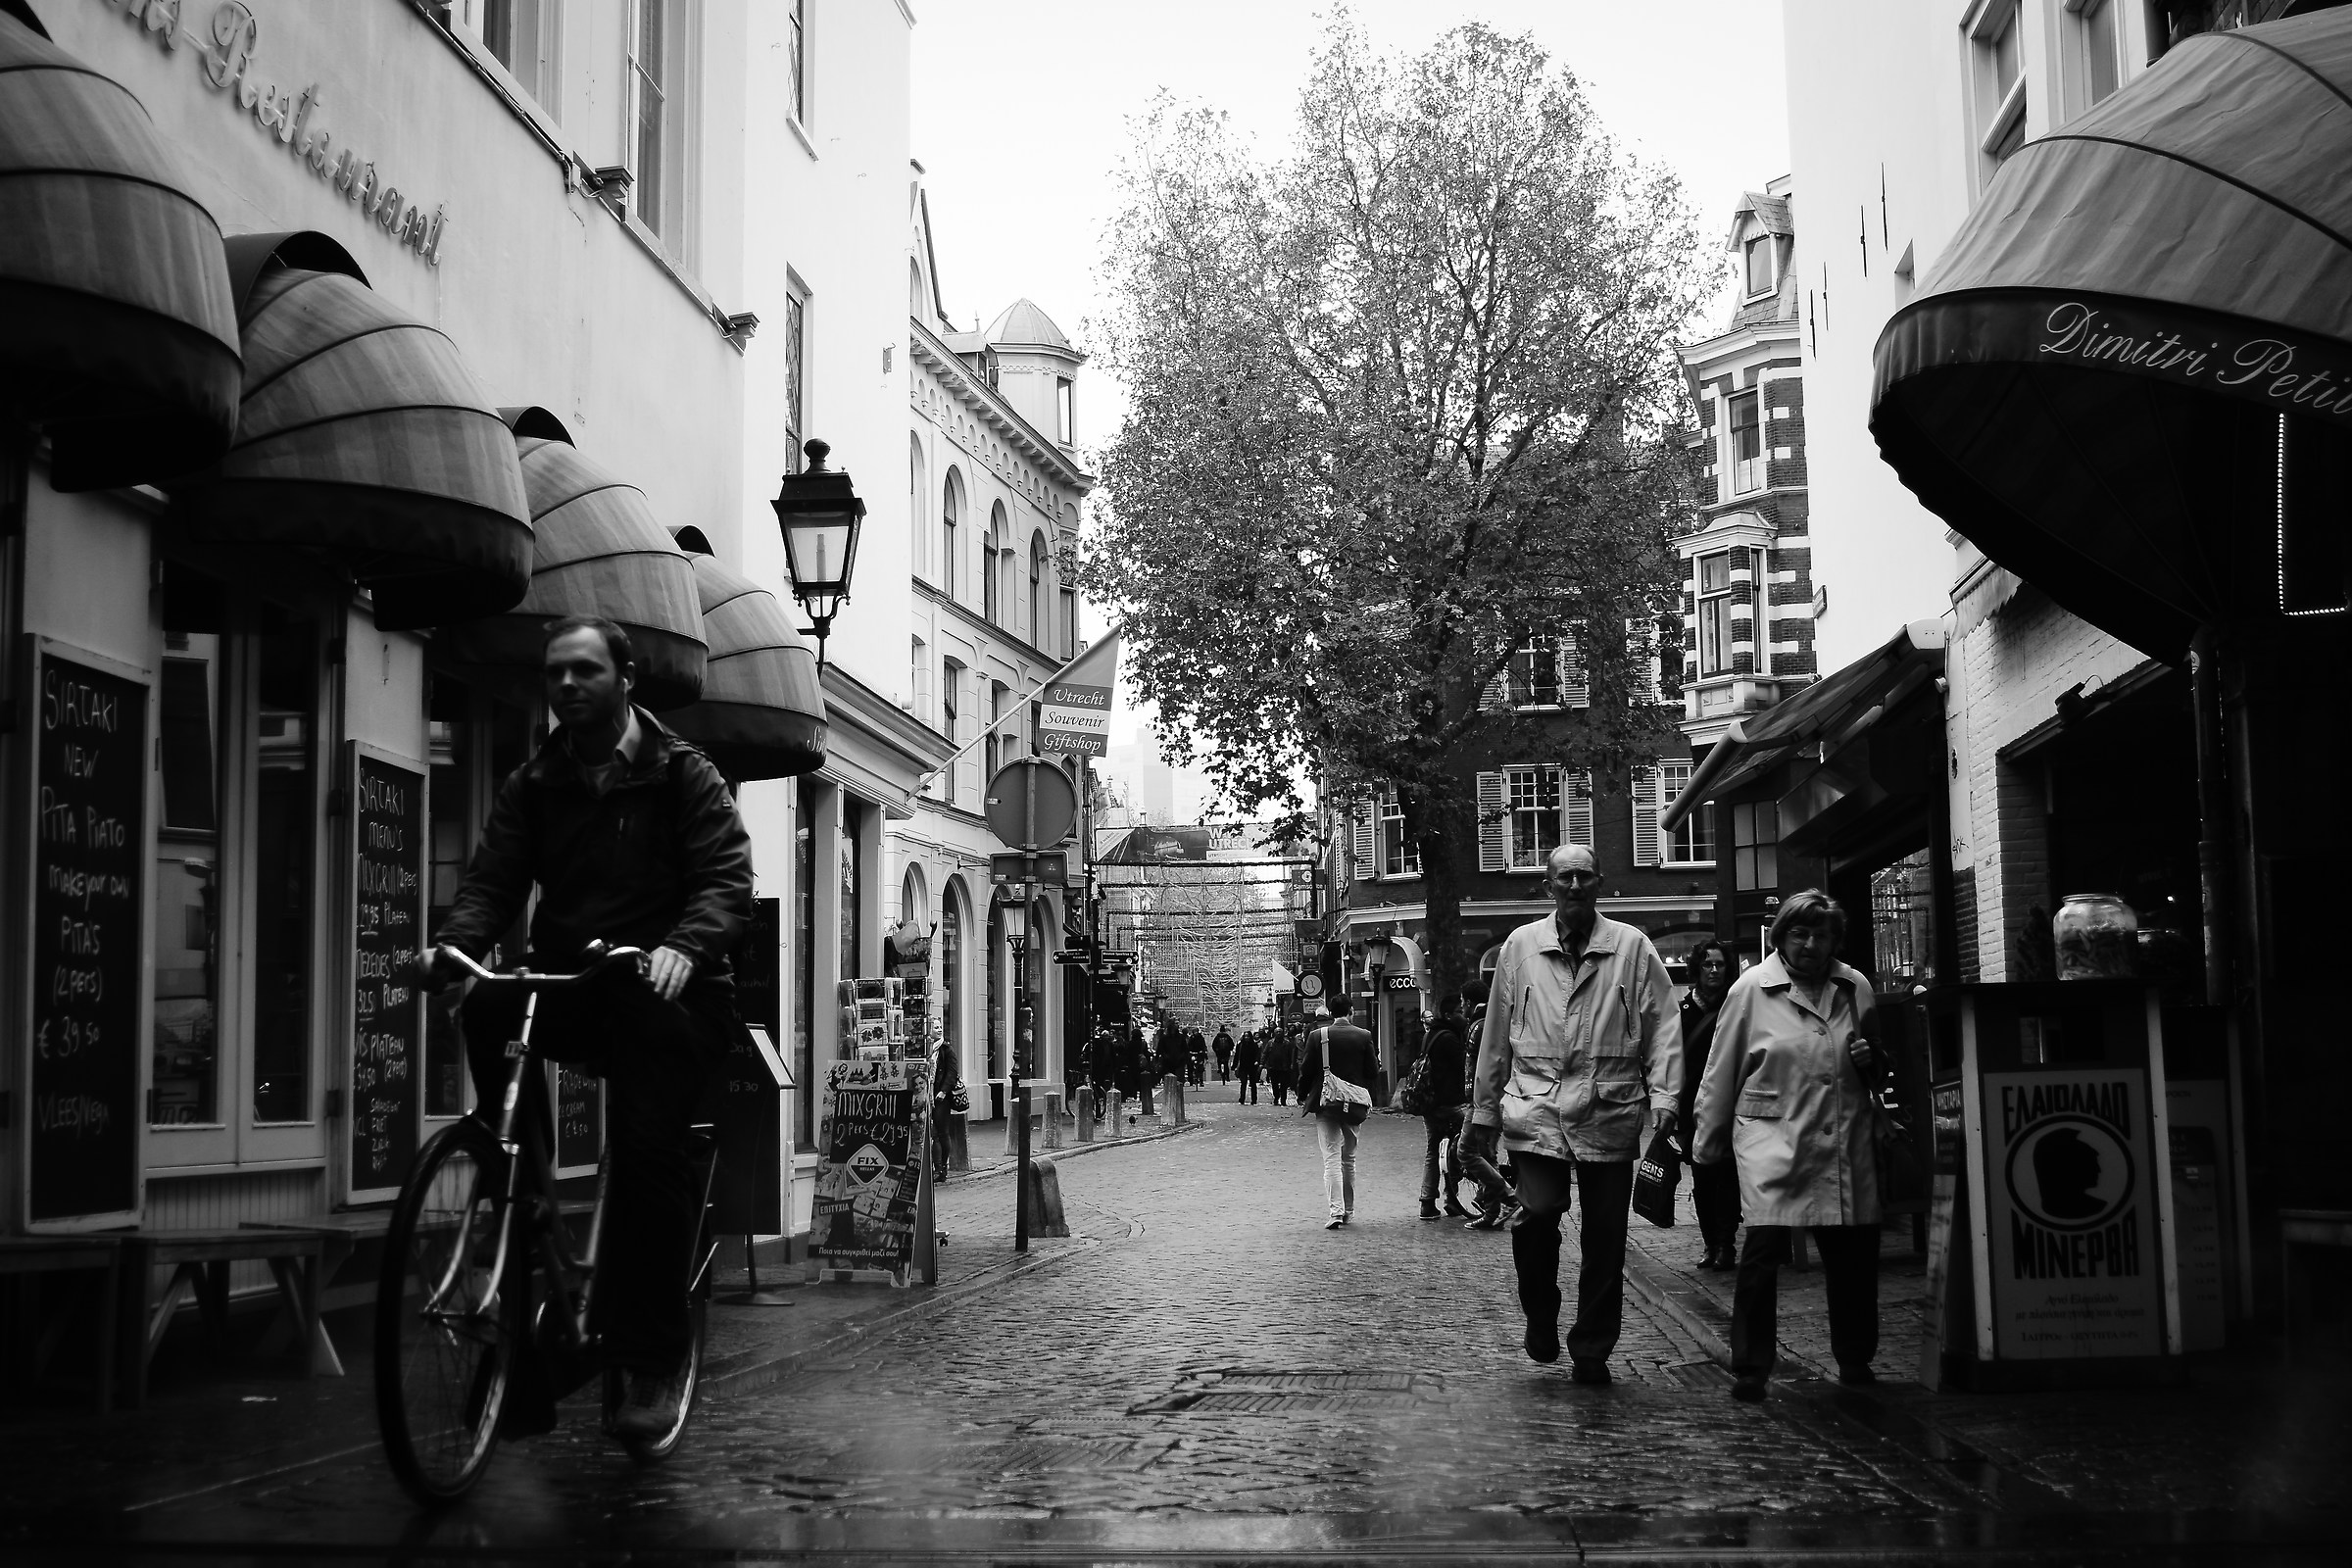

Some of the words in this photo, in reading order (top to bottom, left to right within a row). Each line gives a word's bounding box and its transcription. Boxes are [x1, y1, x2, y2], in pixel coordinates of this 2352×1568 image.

[207, 0, 447, 267] Restaurant
[2039, 302, 2218, 376] Dimitri
[45, 669, 117, 733] SIRTAKI
[1054, 688, 1104, 705] Utrecht
[1045, 711, 1104, 727] Souvenir
[65, 742, 99, 779] NEW
[1044, 733, 1101, 755] Giftshop
[359, 767, 405, 815] SIRTAKI
[857, 1156, 879, 1165] FIX
[819, 1202, 850, 1214] ΕΠΙΤΥΧΙΑ
[2011, 1204, 2140, 1280] ΜΙΝΕΡΒΑ
